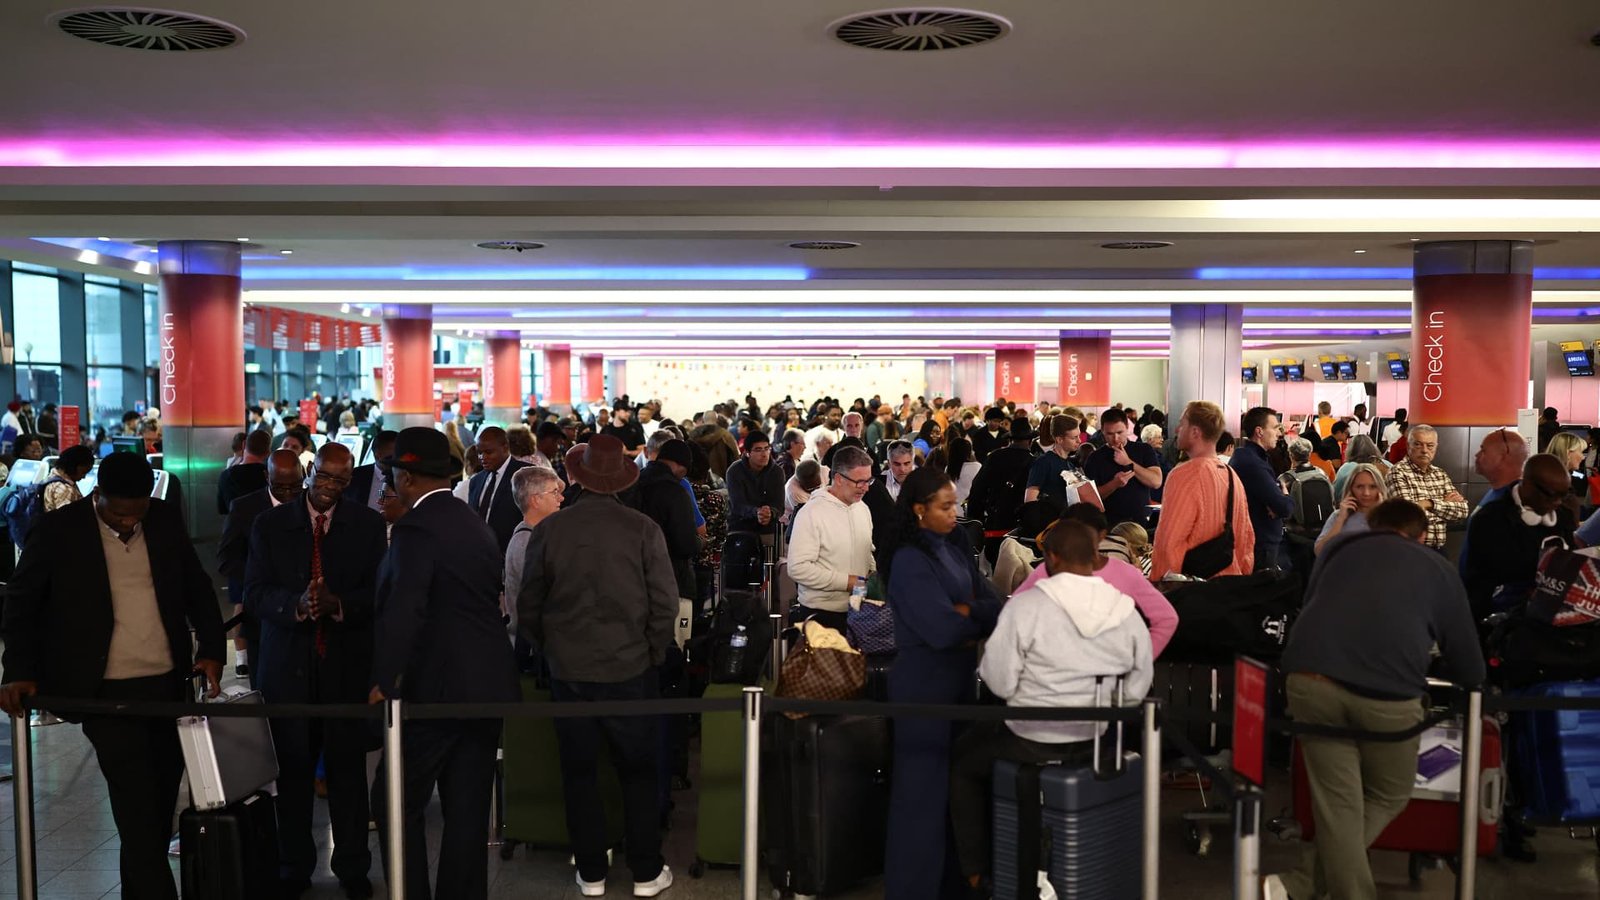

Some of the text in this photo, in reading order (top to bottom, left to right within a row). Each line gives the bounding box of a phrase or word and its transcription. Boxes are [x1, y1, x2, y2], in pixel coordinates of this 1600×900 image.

[161, 312, 176, 405] Check in
[385, 342, 395, 401] Check in
[1067, 364, 1078, 397] Check
[1423, 311, 1444, 402] Check in
